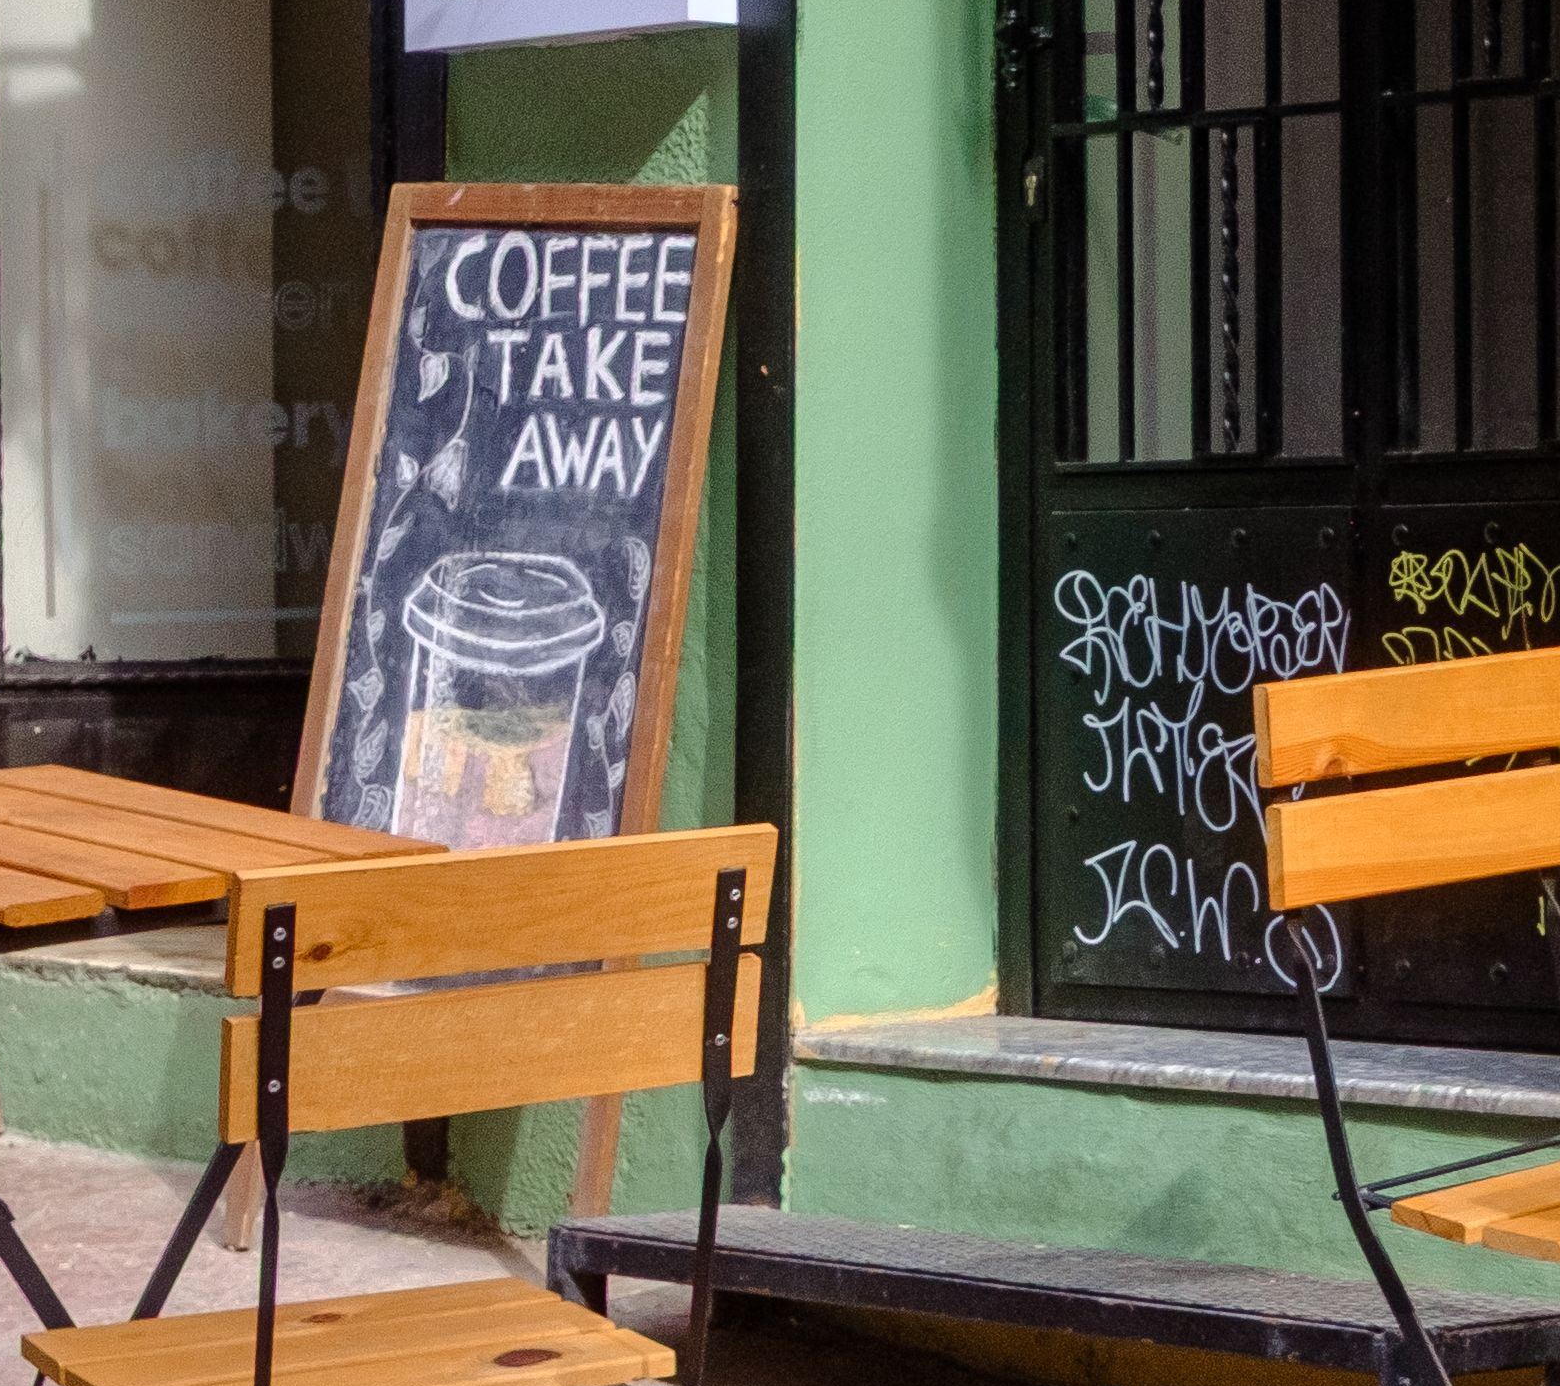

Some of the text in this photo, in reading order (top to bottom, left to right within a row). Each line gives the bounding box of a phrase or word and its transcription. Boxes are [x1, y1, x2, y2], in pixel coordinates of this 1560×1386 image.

[445, 230, 697, 323] COFFEE
[487, 329, 672, 406] TAKE
[500, 413, 663, 496] AWAY
